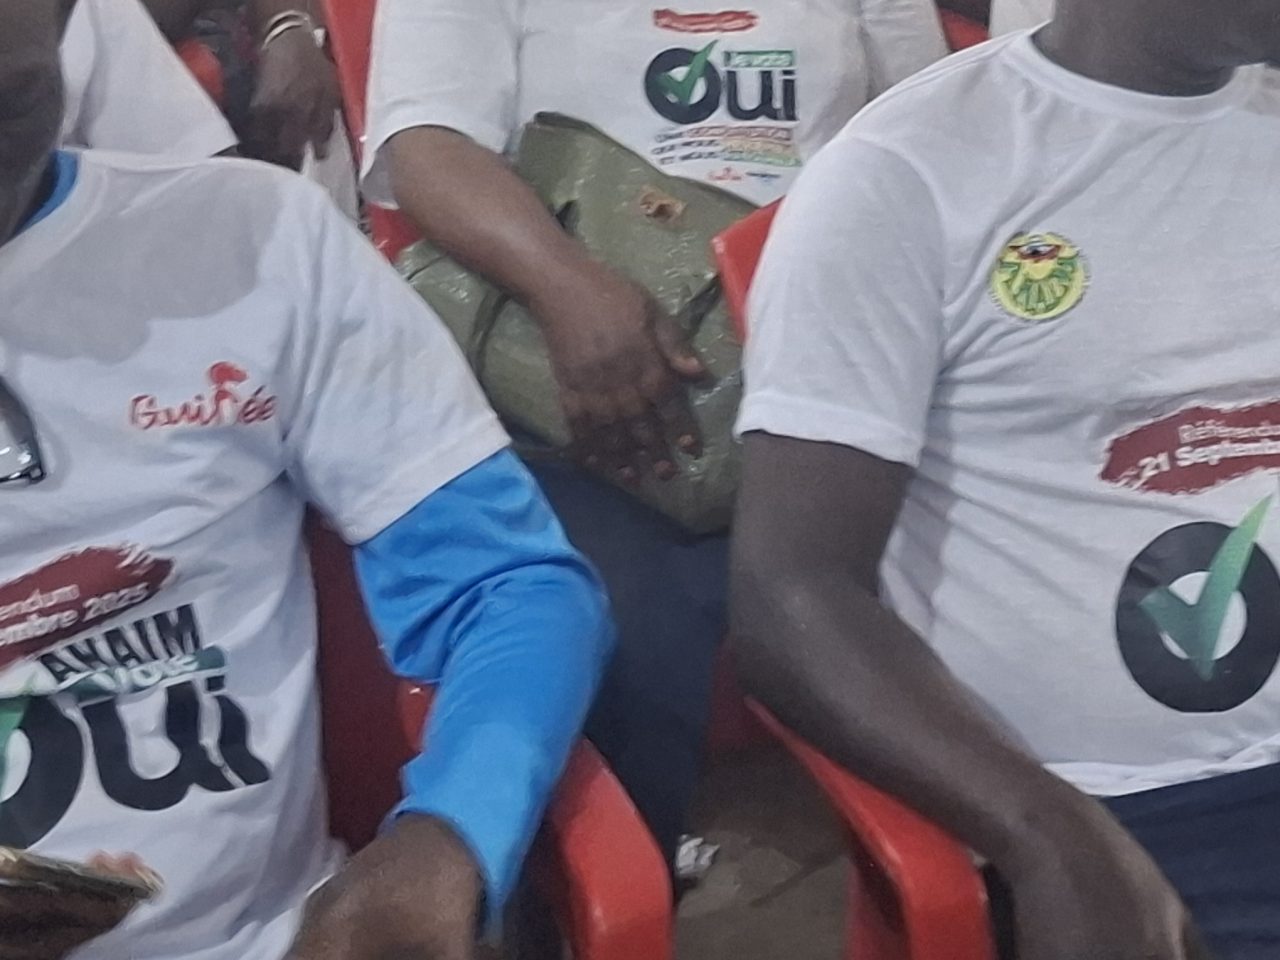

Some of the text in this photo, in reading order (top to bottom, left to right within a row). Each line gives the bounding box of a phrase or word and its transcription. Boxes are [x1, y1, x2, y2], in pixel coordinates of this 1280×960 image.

[645, 40, 797, 125] Oui
[1139, 452, 1171, 478] 21
[40, 602, 201, 685] ANAIM
